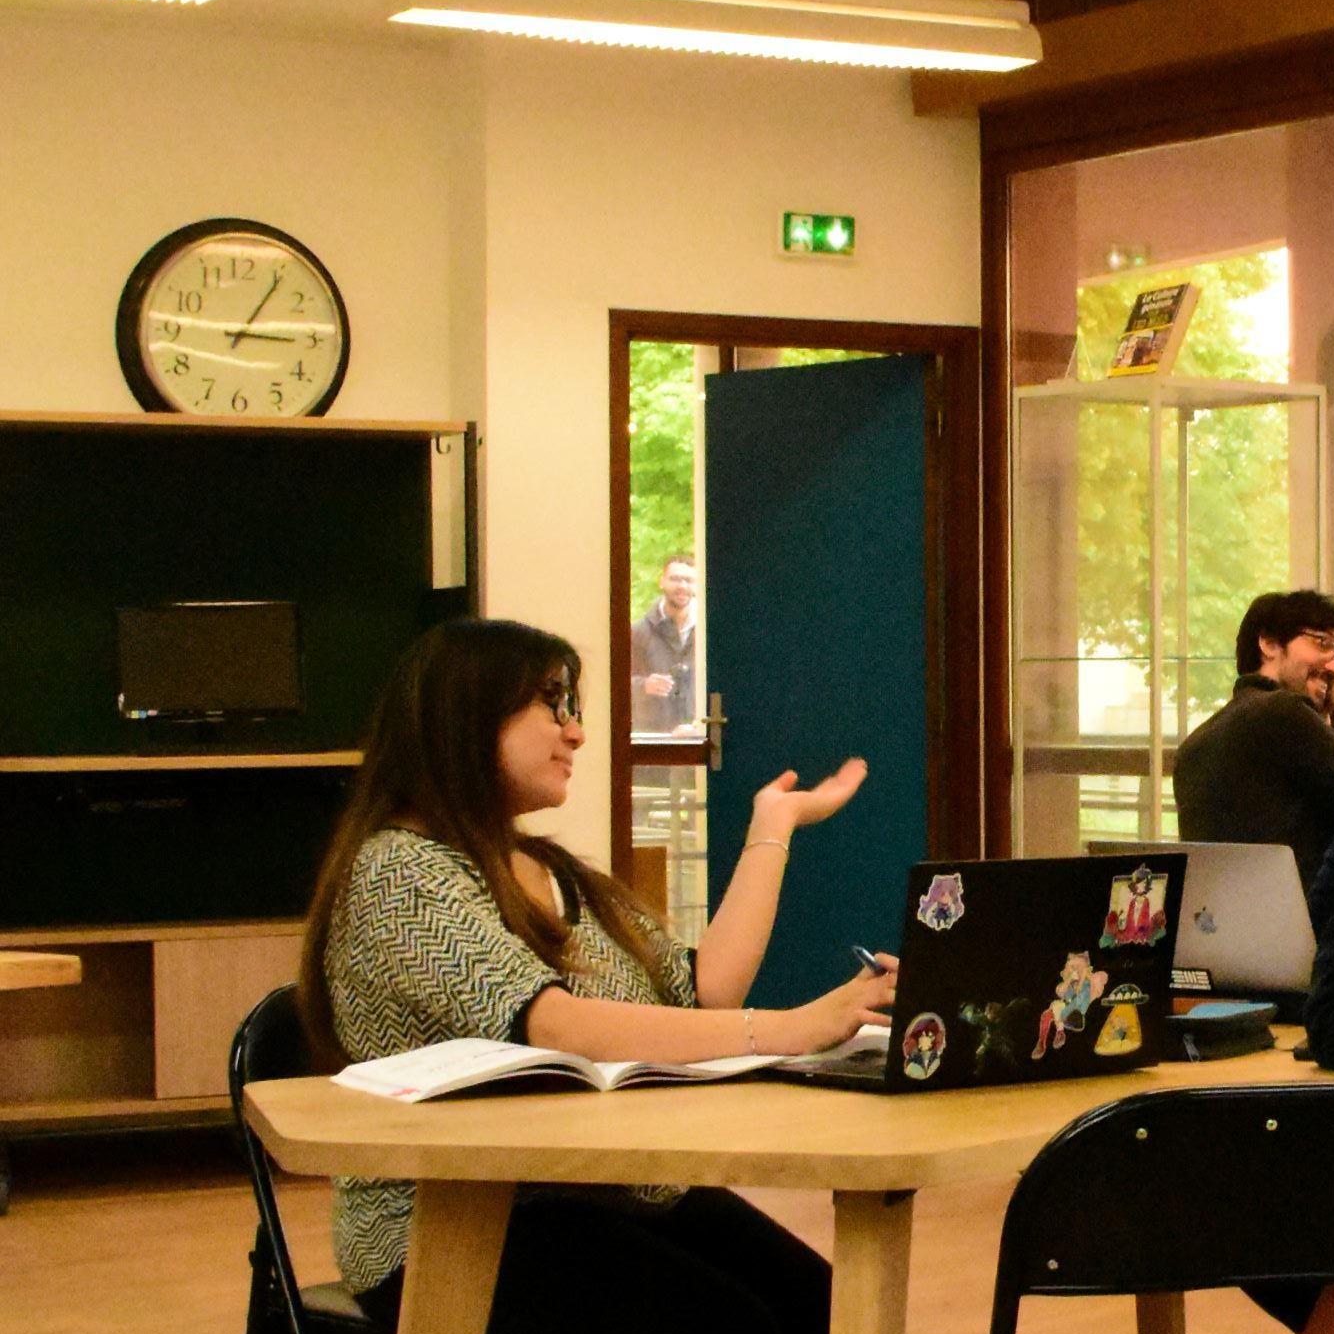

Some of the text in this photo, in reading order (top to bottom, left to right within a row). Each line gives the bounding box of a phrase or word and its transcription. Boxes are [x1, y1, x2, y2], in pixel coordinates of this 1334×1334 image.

[203, 265, 221, 289] 11
[229, 259, 255, 281] 12
[177, 290, 202, 313] 10
[290, 291, 305, 314] 2
[164, 320, 181, 342] 9
[306, 331, 318, 349] 3
[173, 353, 190, 376] 8
[290, 360, 305, 381] 4
[202, 378, 216, 401] 7
[231, 389, 248, 412] 6
[270, 382, 283, 404] 5
